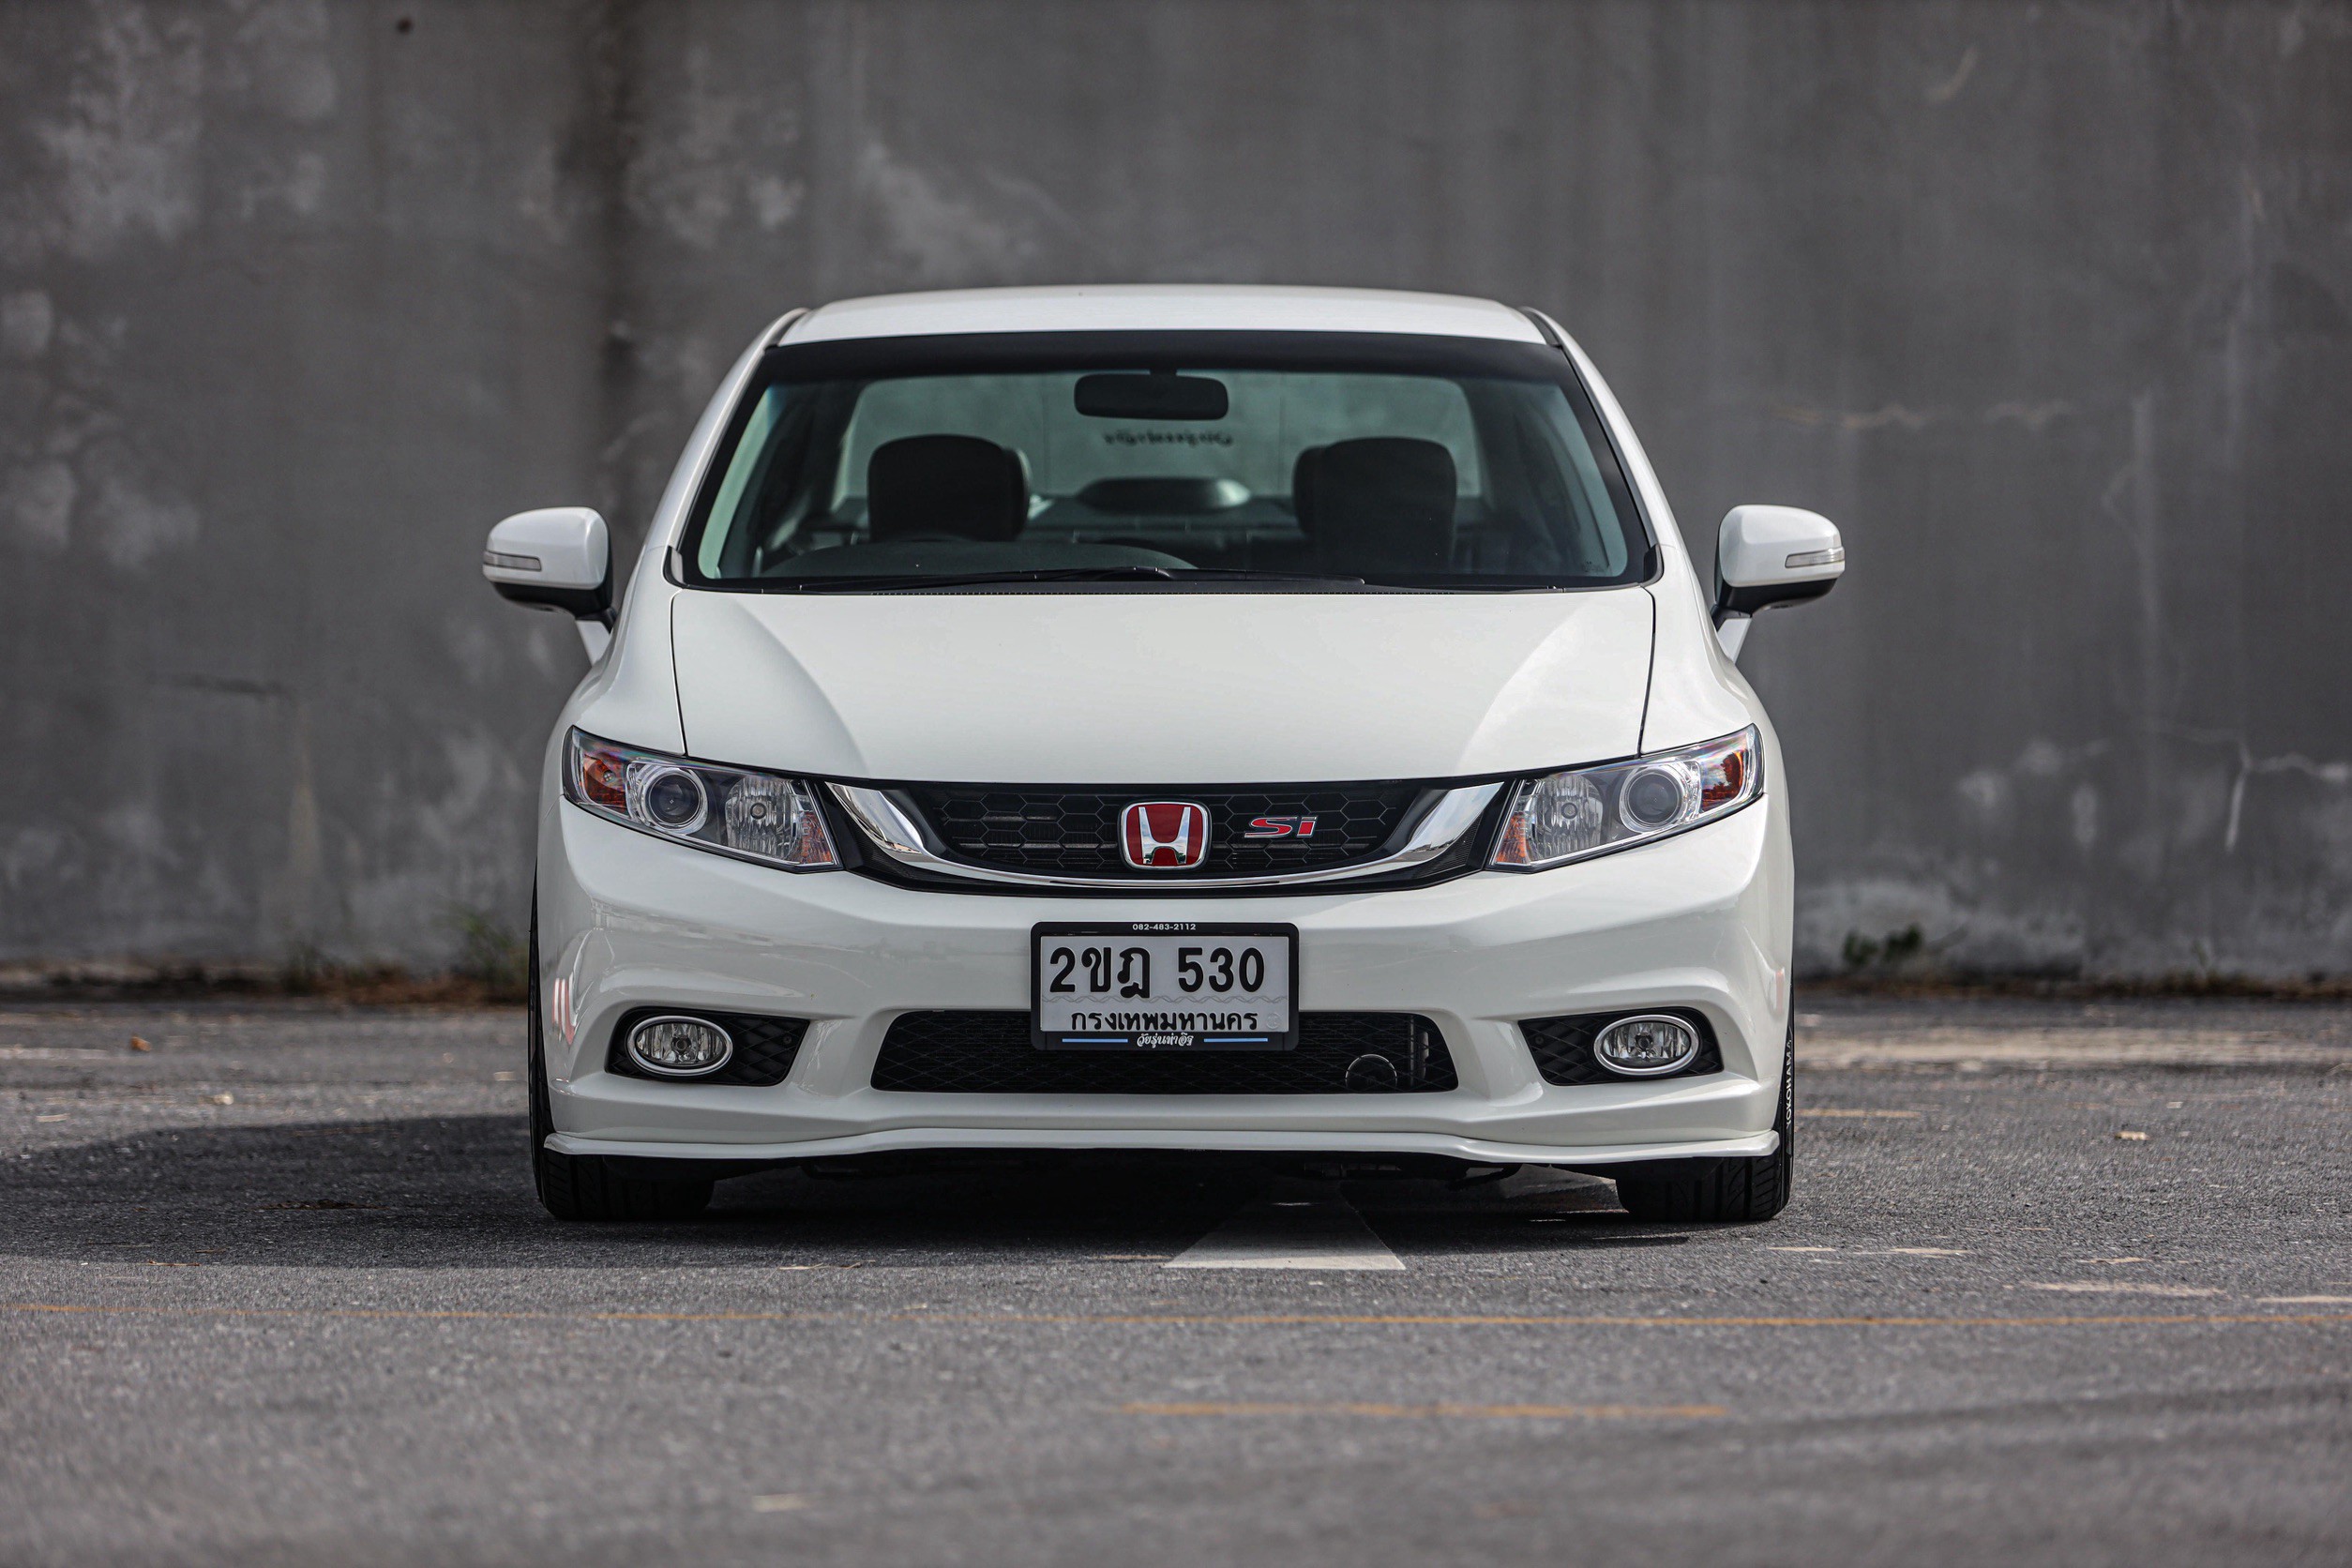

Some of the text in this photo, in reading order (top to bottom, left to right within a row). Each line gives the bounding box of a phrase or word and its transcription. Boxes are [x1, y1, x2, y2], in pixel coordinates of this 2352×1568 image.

[1138, 807, 1191, 865] H
[1132, 923, 1196, 931] 082-483-2112
[1178, 947, 1265, 993] 530
[1071, 1011, 1258, 1031] กรงเทพมหานคร
